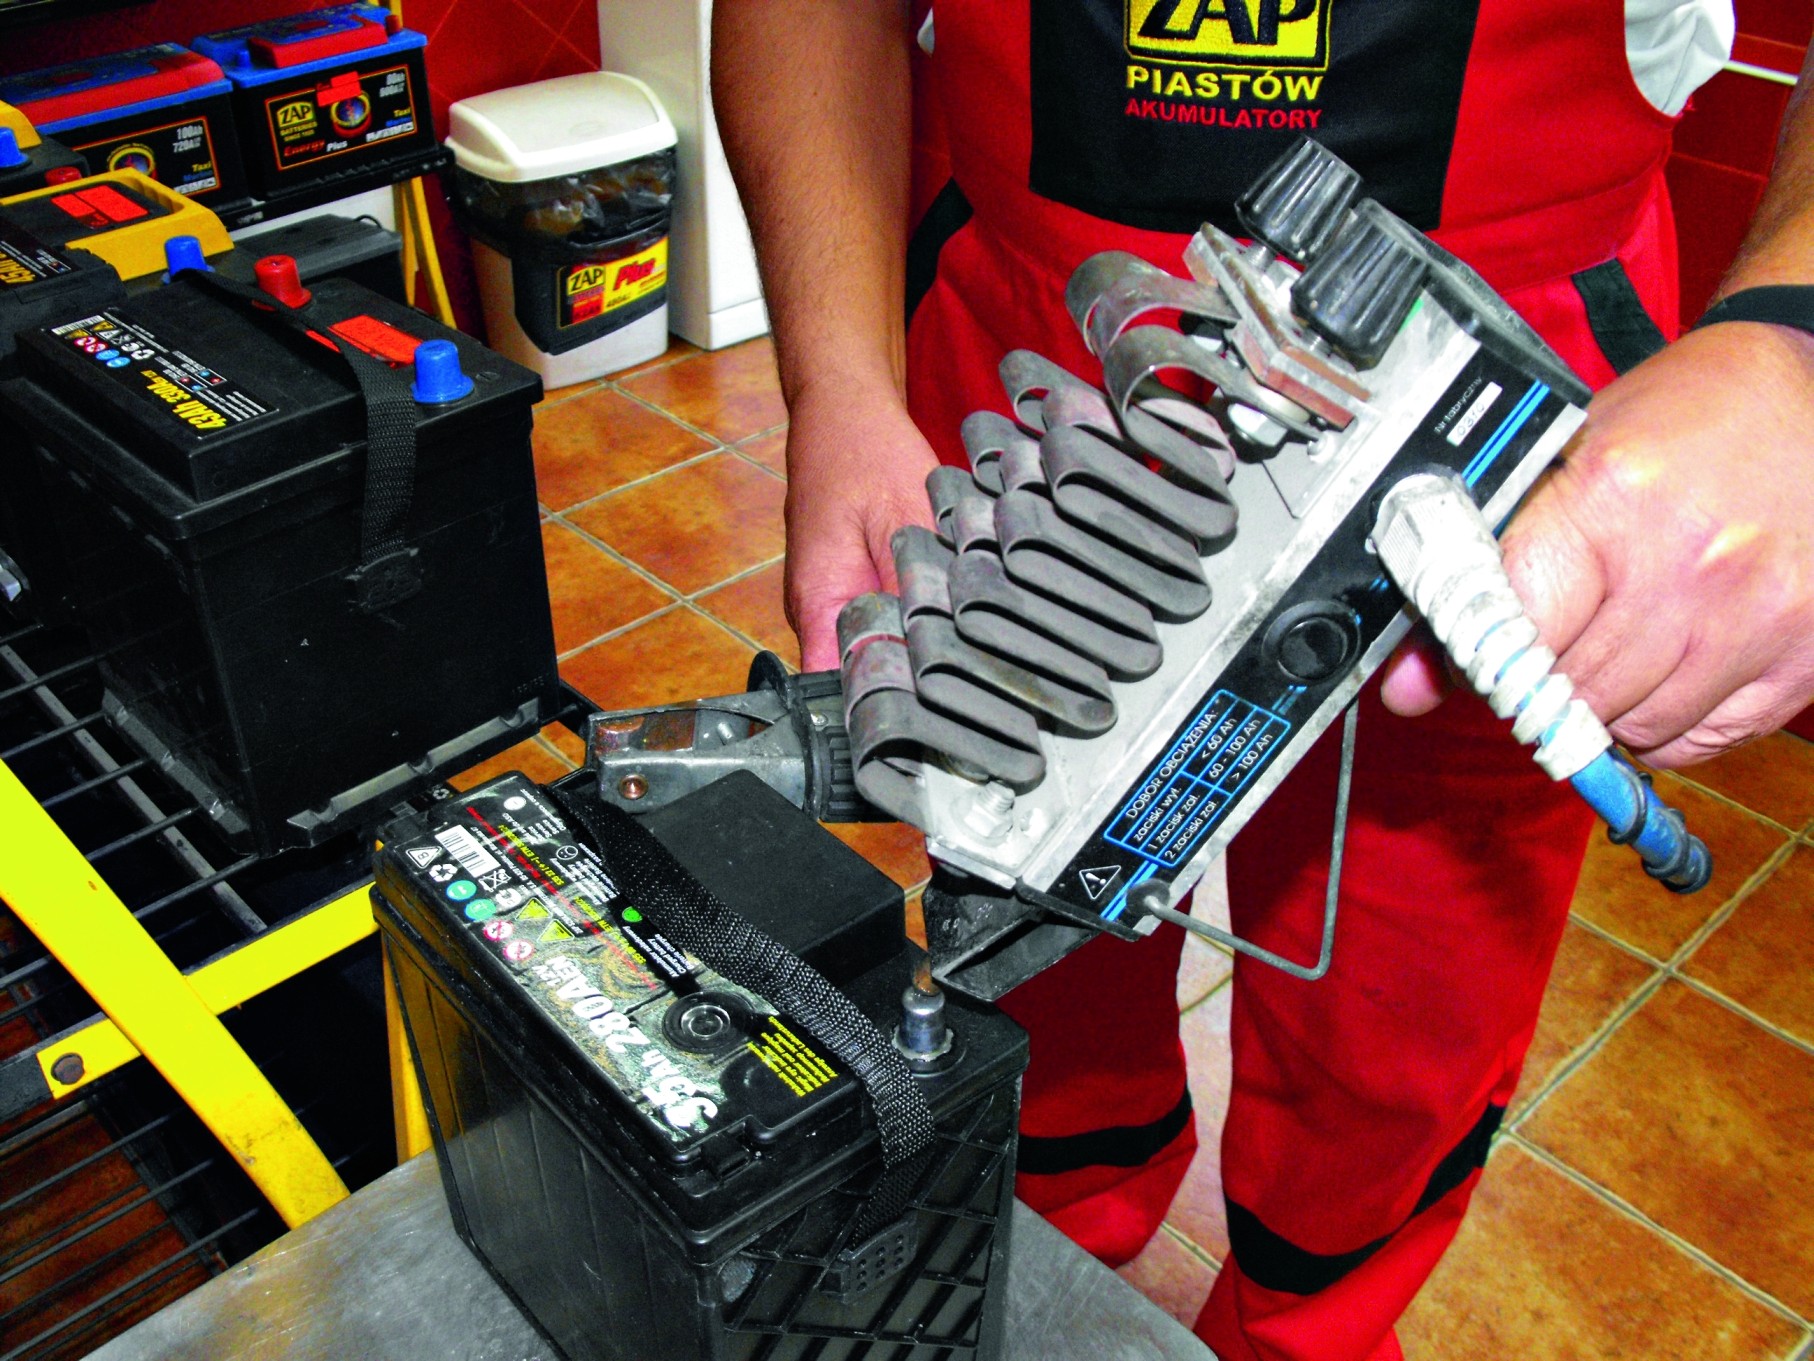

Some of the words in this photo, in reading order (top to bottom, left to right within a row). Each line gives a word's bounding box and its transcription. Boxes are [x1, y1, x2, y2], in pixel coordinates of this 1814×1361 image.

[1138, 0, 1318, 46] ZAP
[1126, 65, 1324, 101] PIASTÓW
[278, 104, 312, 125] ZAP
[1125, 98, 1323, 129] AKUMULATORY
[284, 140, 325, 157] Energy
[326, 140, 348, 152] Plus
[571, 268, 603, 291] ZAP
[613, 258, 656, 291] Plus
[147, 379, 190, 402] 330A
[173, 400, 225, 428] 43Ah
[1207, 734, 1222, 749] 60
[1219, 718, 1235, 735] Ah
[1208, 762, 1223, 777] 60
[1225, 735, 1246, 754] 100
[1243, 719, 1259, 736] Ah
[1238, 750, 1258, 768] 100
[1255, 734, 1272, 750] Ah
[1126, 777, 1163, 818] DOBÓR
[1133, 807, 1163, 841] zaciski
[1161, 787, 1181, 806] wył.
[1155, 811, 1183, 843] zacisk
[1181, 794, 1200, 811] zał.
[527, 825, 545, 841] Service
[535, 822, 552, 838] Service
[542, 819, 559, 834] Service
[1164, 850, 1175, 858] 2
[1172, 817, 1202, 850] zaciski
[647, 938, 666, 955] battery
[531, 964, 560, 986] 12V
[649, 951, 679, 977] Akumulator
[662, 953, 686, 973] Charged
[556, 974, 649, 1053] 280A
[768, 1016, 805, 1048] Ladezustands
[762, 1045, 787, 1066] indicator
[803, 1047, 815, 1057] des
[784, 1065, 797, 1076] eye
[813, 1056, 837, 1077] Anzeige
[795, 1075, 813, 1091] Magic
